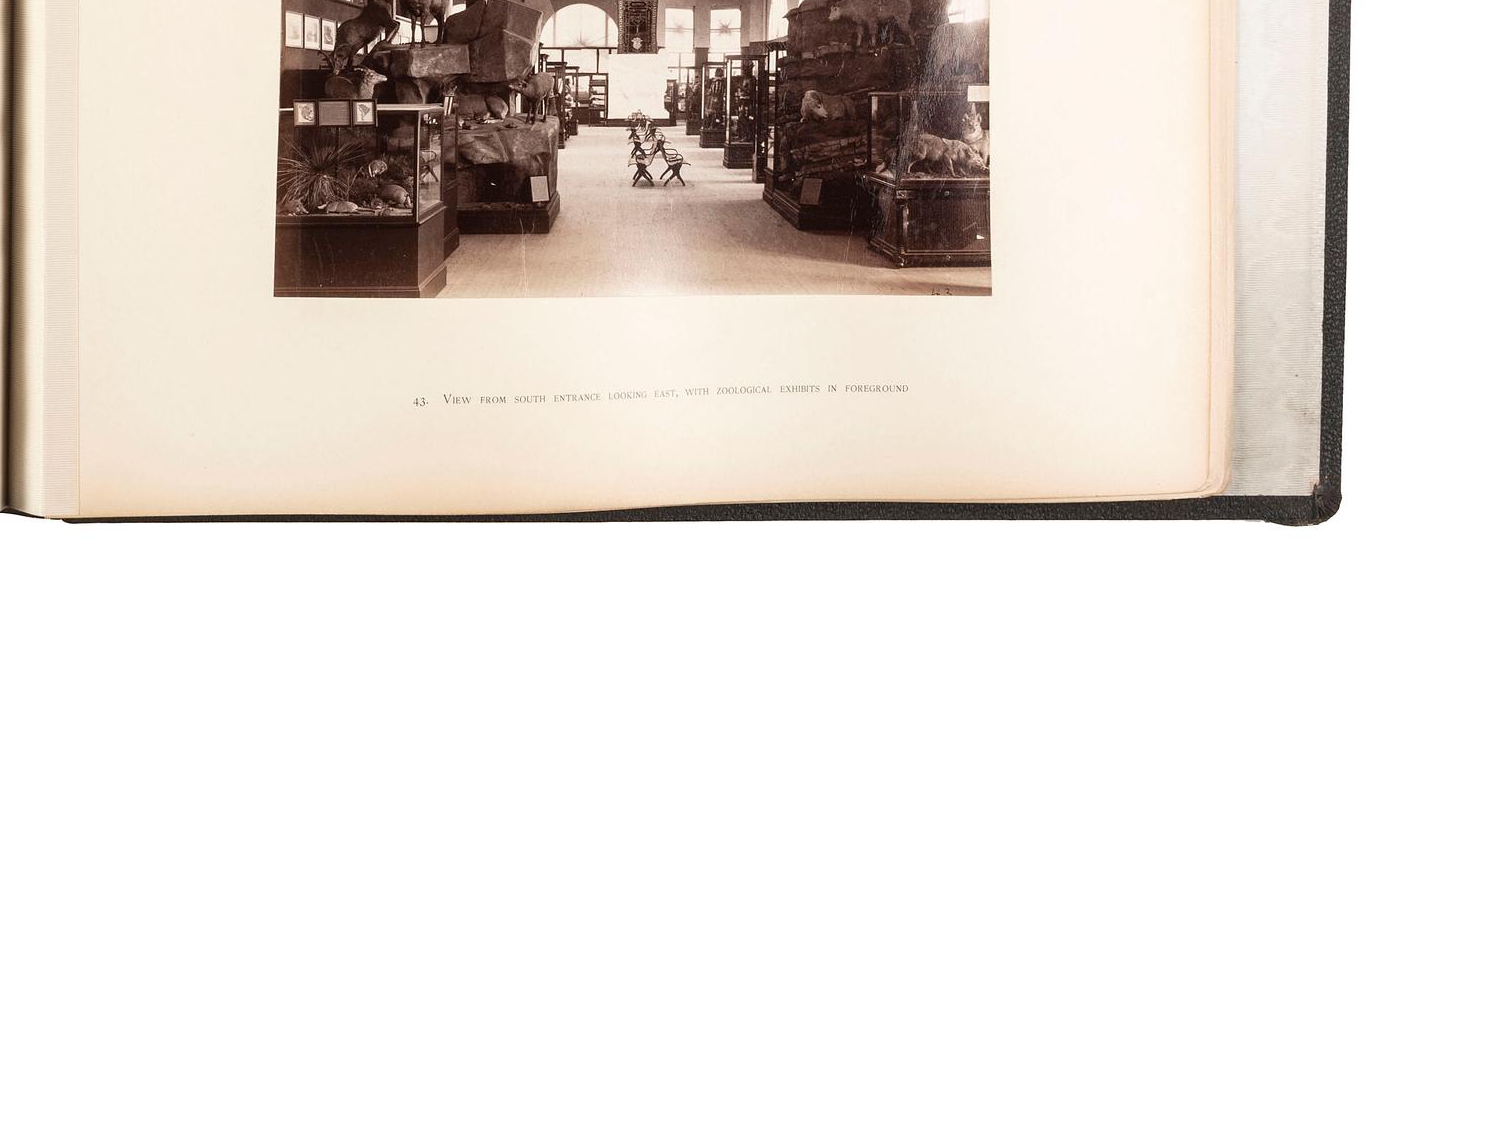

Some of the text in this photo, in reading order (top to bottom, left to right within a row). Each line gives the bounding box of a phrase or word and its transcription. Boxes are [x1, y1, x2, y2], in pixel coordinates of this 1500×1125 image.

[412, 384, 909, 407] 43. VIEW FROM SOUTH ENTRANCE LOOKING EAST, WITH ZOOLOGICAL EXHIBITS IN FOREGROUND
